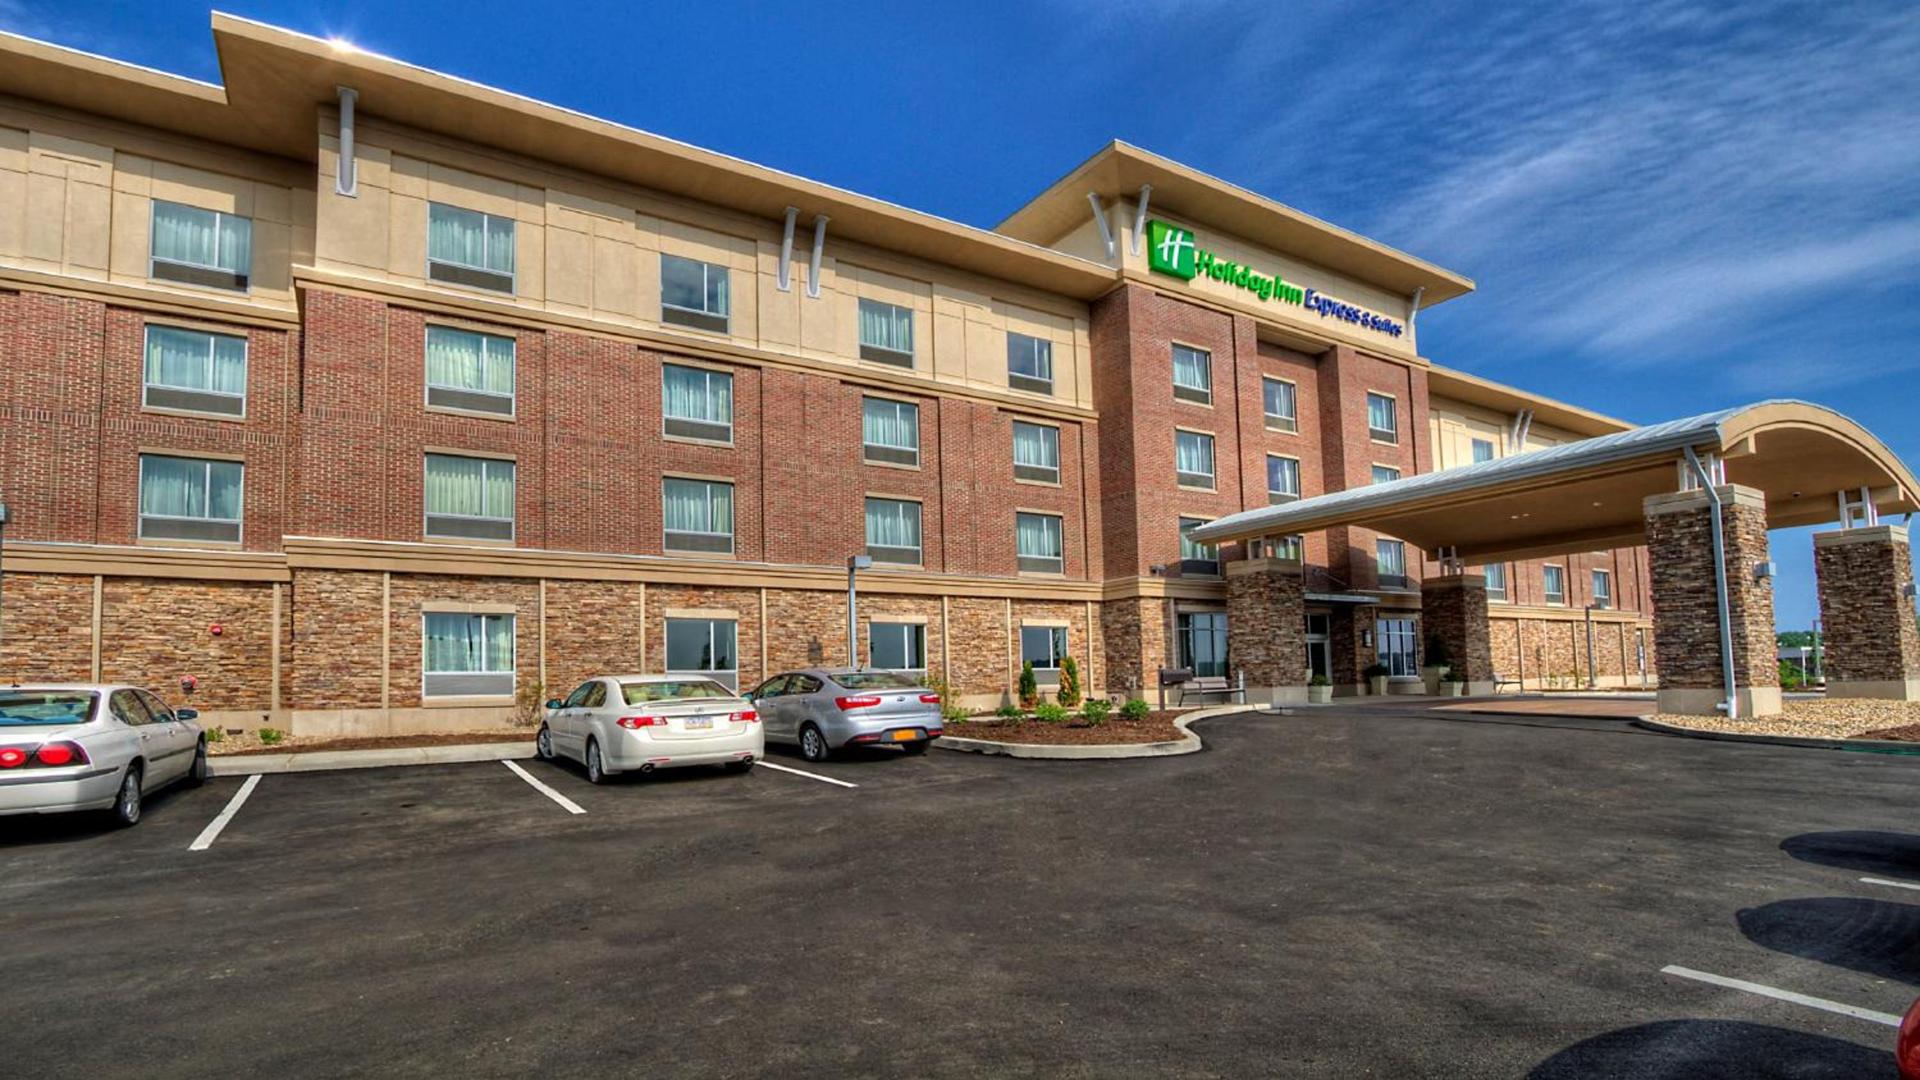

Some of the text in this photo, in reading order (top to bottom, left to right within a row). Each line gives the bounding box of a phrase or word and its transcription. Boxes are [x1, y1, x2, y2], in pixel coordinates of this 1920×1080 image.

[1195, 249, 1402, 337] Holiday Inn Express & Suites
